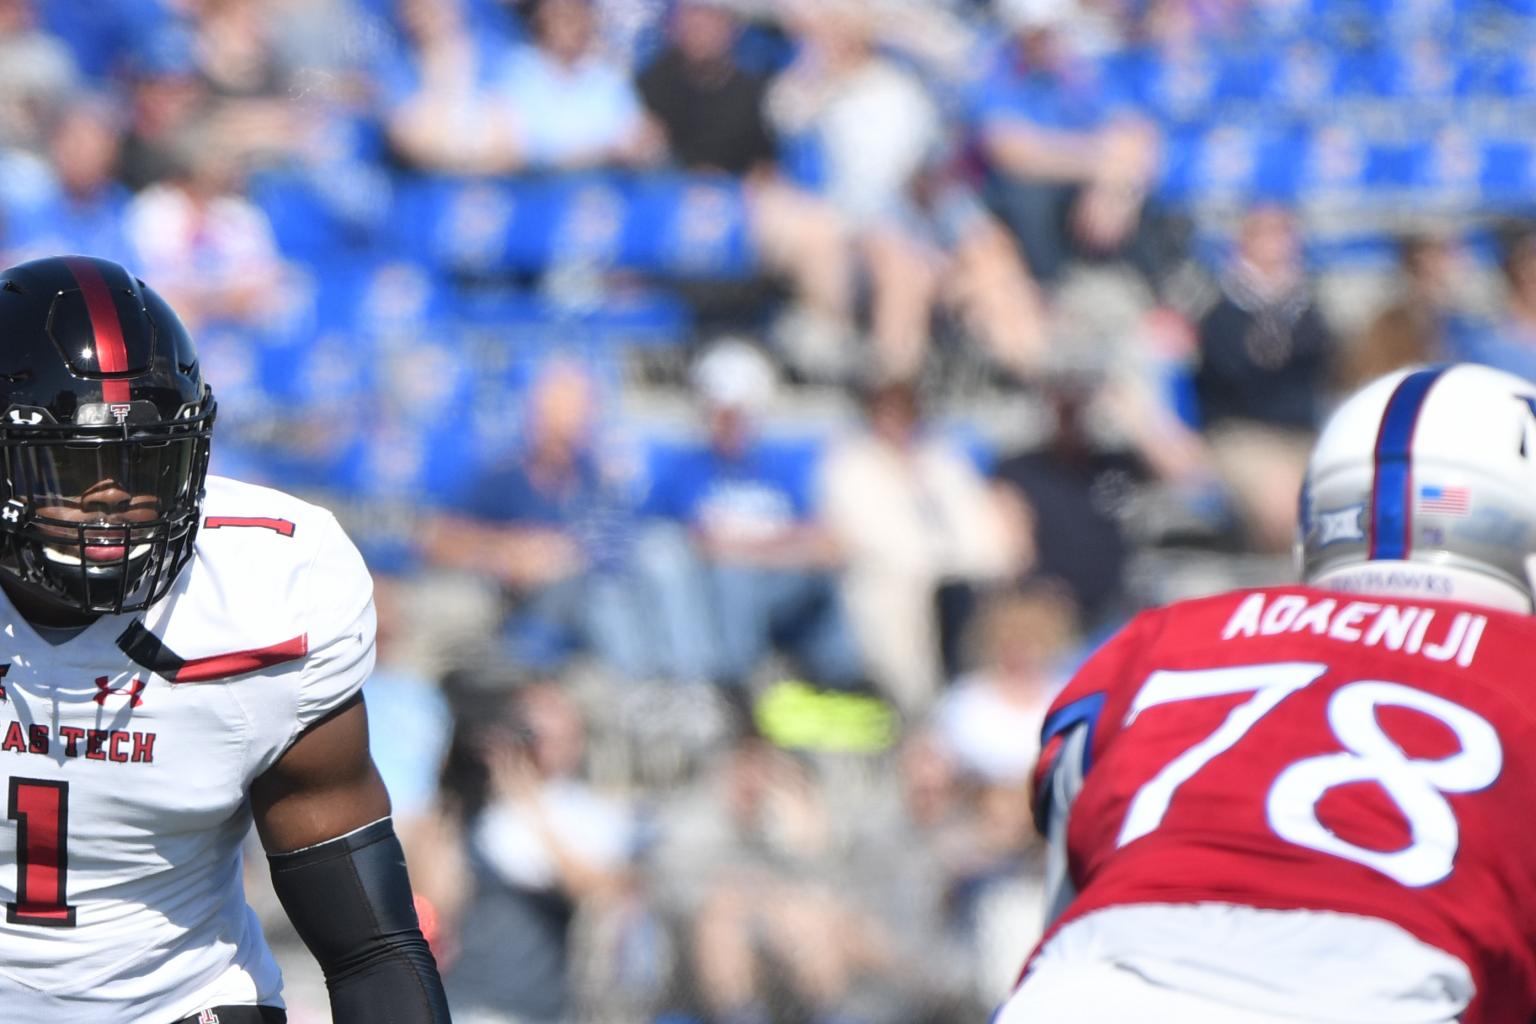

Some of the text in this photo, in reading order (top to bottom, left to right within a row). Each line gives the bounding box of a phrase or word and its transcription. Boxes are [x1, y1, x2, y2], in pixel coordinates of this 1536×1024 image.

[203, 516, 296, 538] 1
[59, 725, 156, 763] TECH
[1116, 660, 1505, 888] 78
[6, 775, 77, 928] 1
